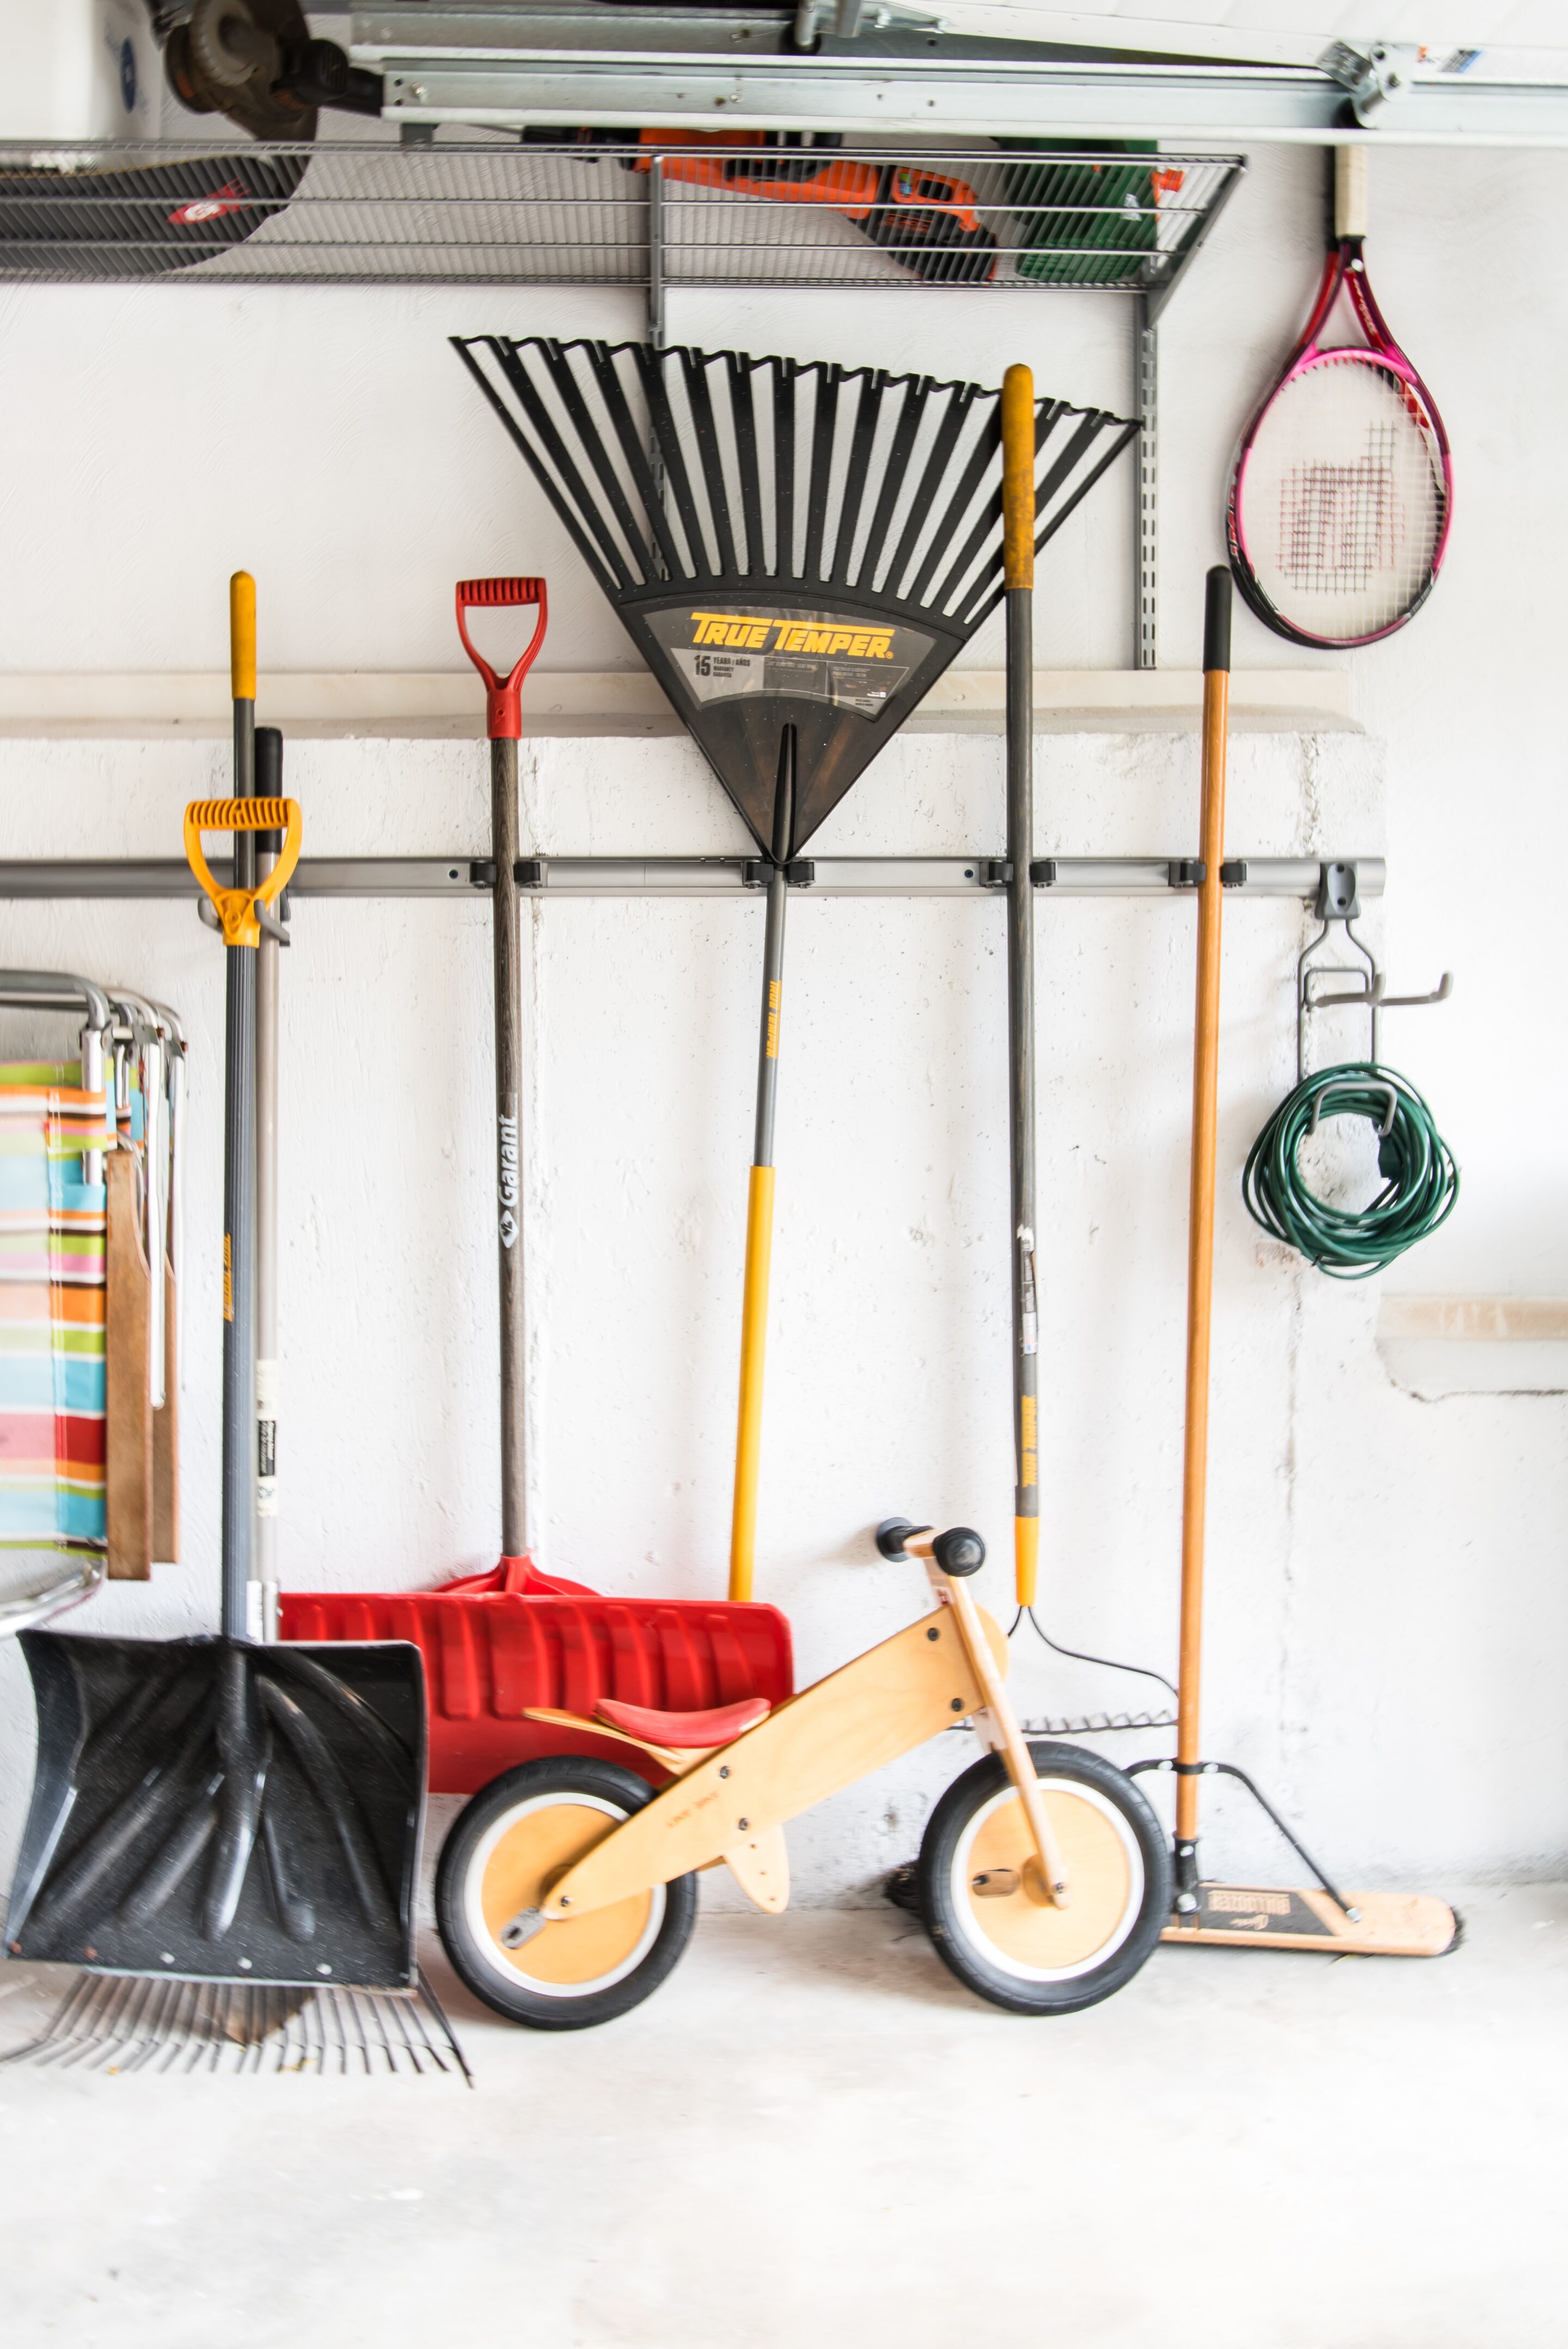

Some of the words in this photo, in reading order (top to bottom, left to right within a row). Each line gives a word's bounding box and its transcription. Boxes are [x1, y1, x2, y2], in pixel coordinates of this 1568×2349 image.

[690, 612, 773, 649] TRUE
[694, 655, 711, 676] 15
[735, 657, 750, 666] AÑOS
[498, 1114, 519, 1207] Garant
